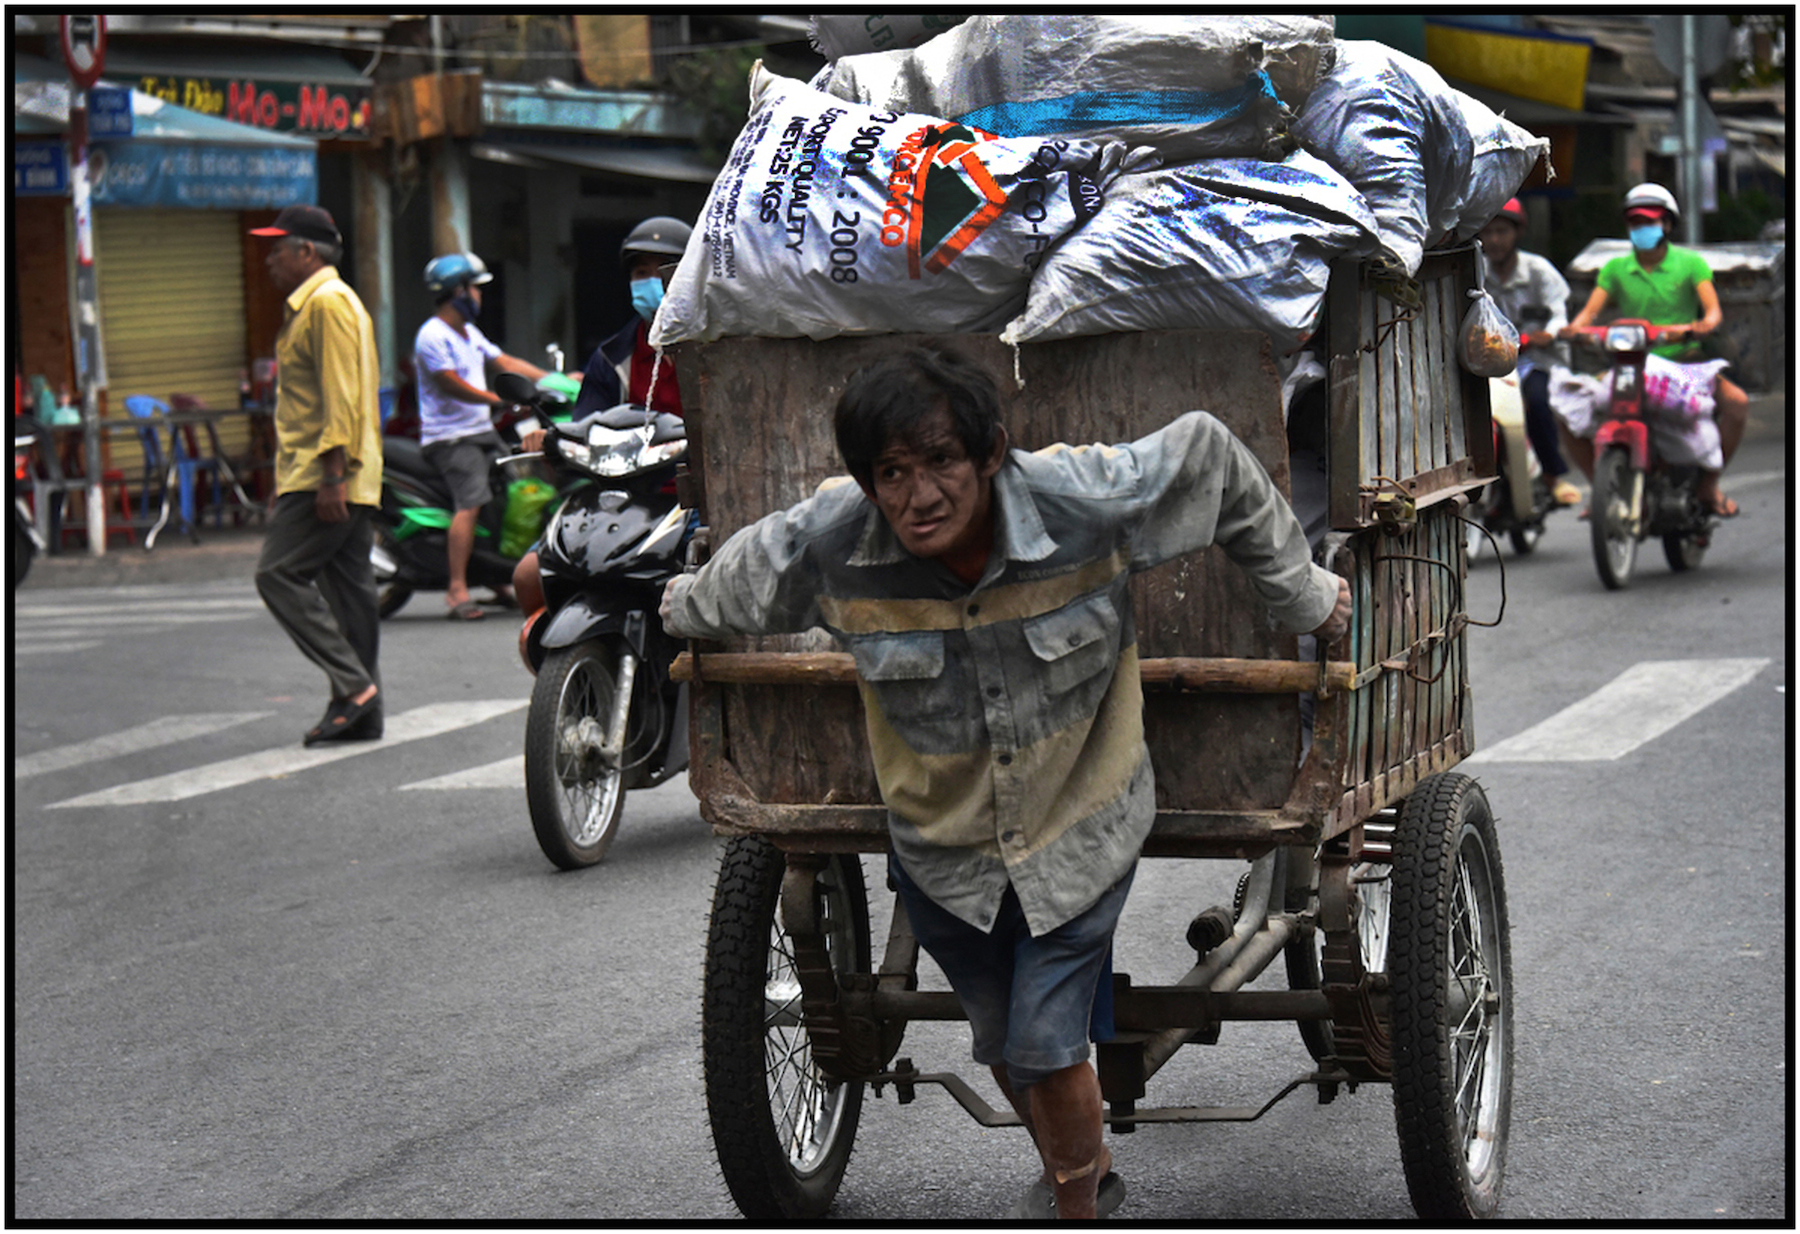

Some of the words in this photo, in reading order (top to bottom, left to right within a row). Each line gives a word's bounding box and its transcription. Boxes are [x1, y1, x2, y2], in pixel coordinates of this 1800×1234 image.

[841, 126, 886, 178] 9001
[759, 181, 785, 224] KGS
[785, 160, 817, 256] QUALITY
[724, 231, 736, 279] VIETNAM
[829, 210, 860, 284] 2008
